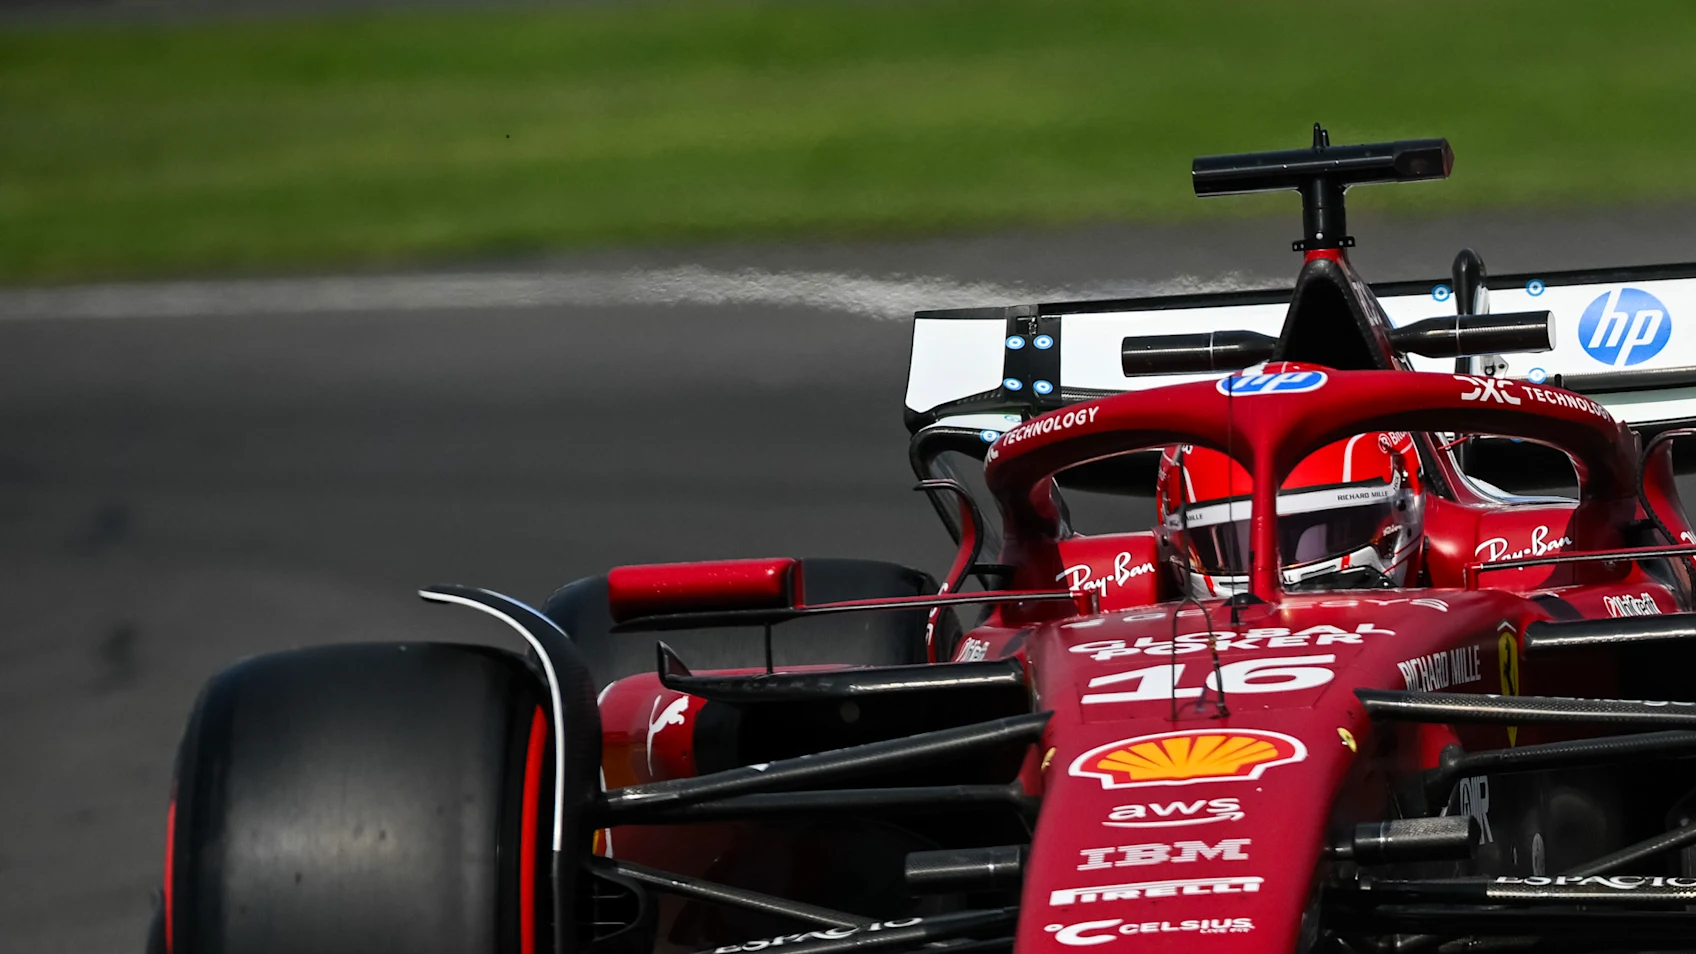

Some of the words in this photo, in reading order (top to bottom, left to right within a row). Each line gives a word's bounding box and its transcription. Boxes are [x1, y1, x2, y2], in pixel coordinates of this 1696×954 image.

[1586, 288, 1664, 366] hp
[1453, 375, 1521, 405] DXC
[1522, 385, 1612, 422] TECHNOLOGY
[1003, 406, 1099, 446] TECHNOLOGY
[1337, 491, 1370, 502] RICHARD
[1371, 490, 1389, 499] MILLE
[1068, 623, 1396, 653] GLOBAL
[1090, 632, 1364, 661] POKER
[1082, 653, 1336, 704] 16
[1397, 650, 1449, 693] RICHARD
[1450, 644, 1482, 686] MILLE
[1108, 797, 1241, 820] aws
[1077, 838, 1251, 871] IBM
[1049, 876, 1264, 906] PIRELLI
[1119, 918, 1253, 934] CELSIUS
